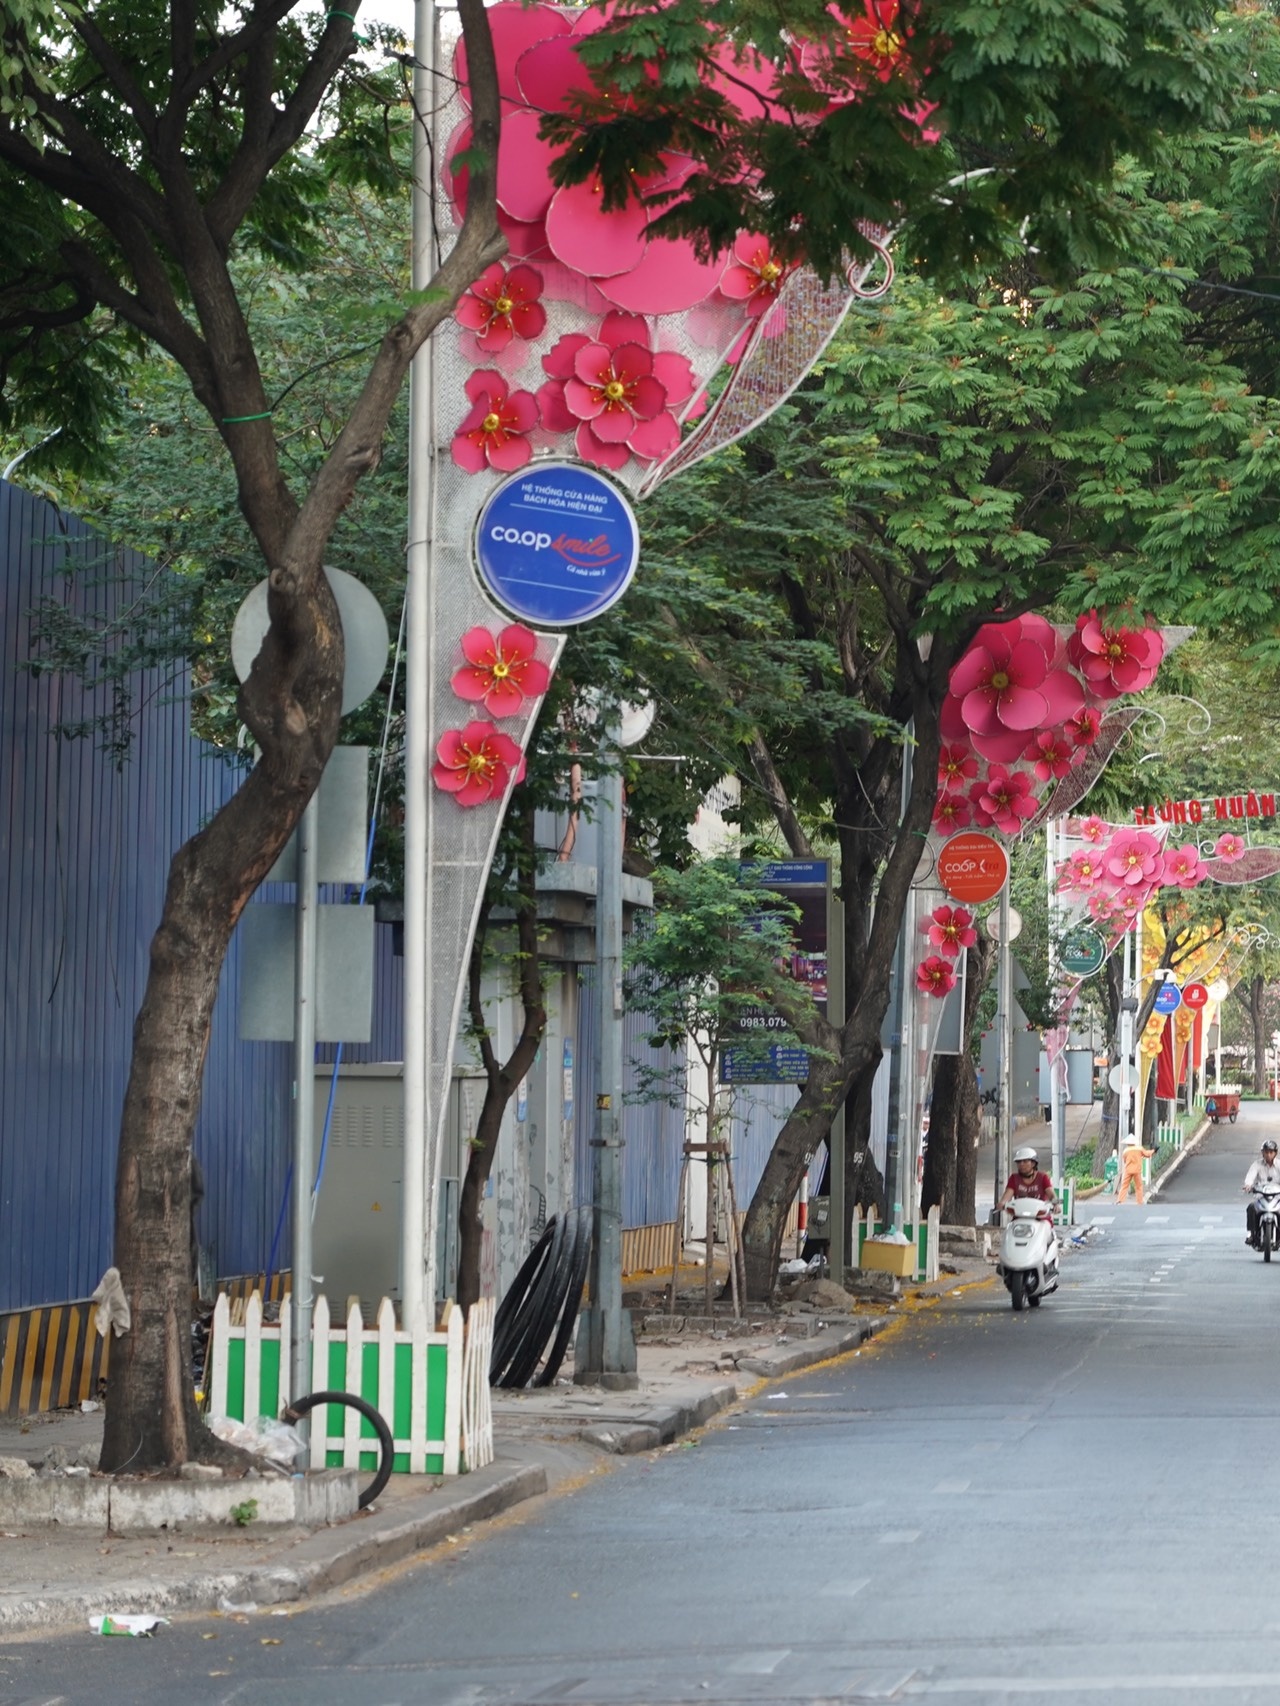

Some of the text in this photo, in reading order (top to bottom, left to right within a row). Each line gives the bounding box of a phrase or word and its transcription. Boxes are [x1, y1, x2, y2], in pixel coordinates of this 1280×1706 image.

[522, 483, 608, 505] HỆ THỐNG CỬA HÀNG
[524, 494, 547, 505] BÁCH
[567, 500, 587, 512] HIỆN
[588, 504, 603, 514] ĐẠI
[491, 525, 551, 551] co.op
[1214, 789, 1276, 820] XUÂN
